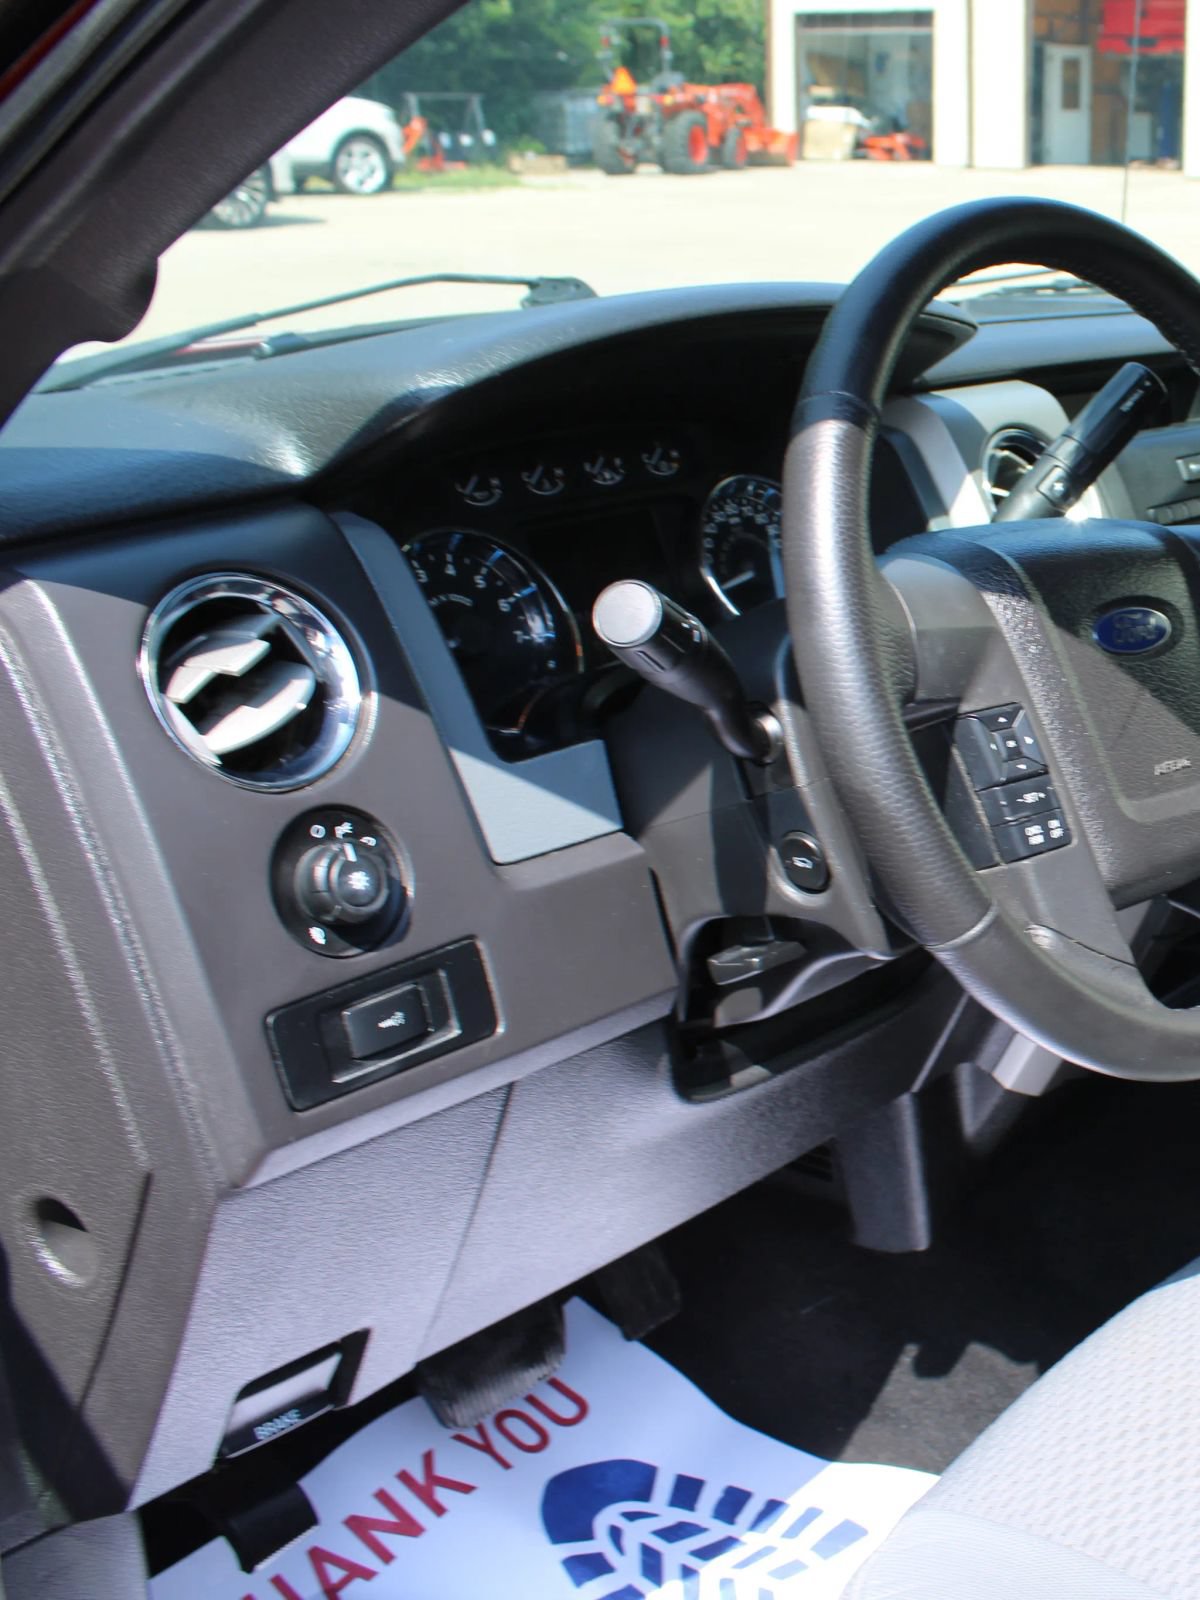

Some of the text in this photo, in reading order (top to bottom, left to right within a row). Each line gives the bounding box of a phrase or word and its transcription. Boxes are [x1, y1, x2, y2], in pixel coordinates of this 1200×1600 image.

[444, 563, 457, 576] 4
[473, 575, 487, 589] 5
[498, 598, 511, 612] 6
[451, 1376, 590, 1471] YOU
